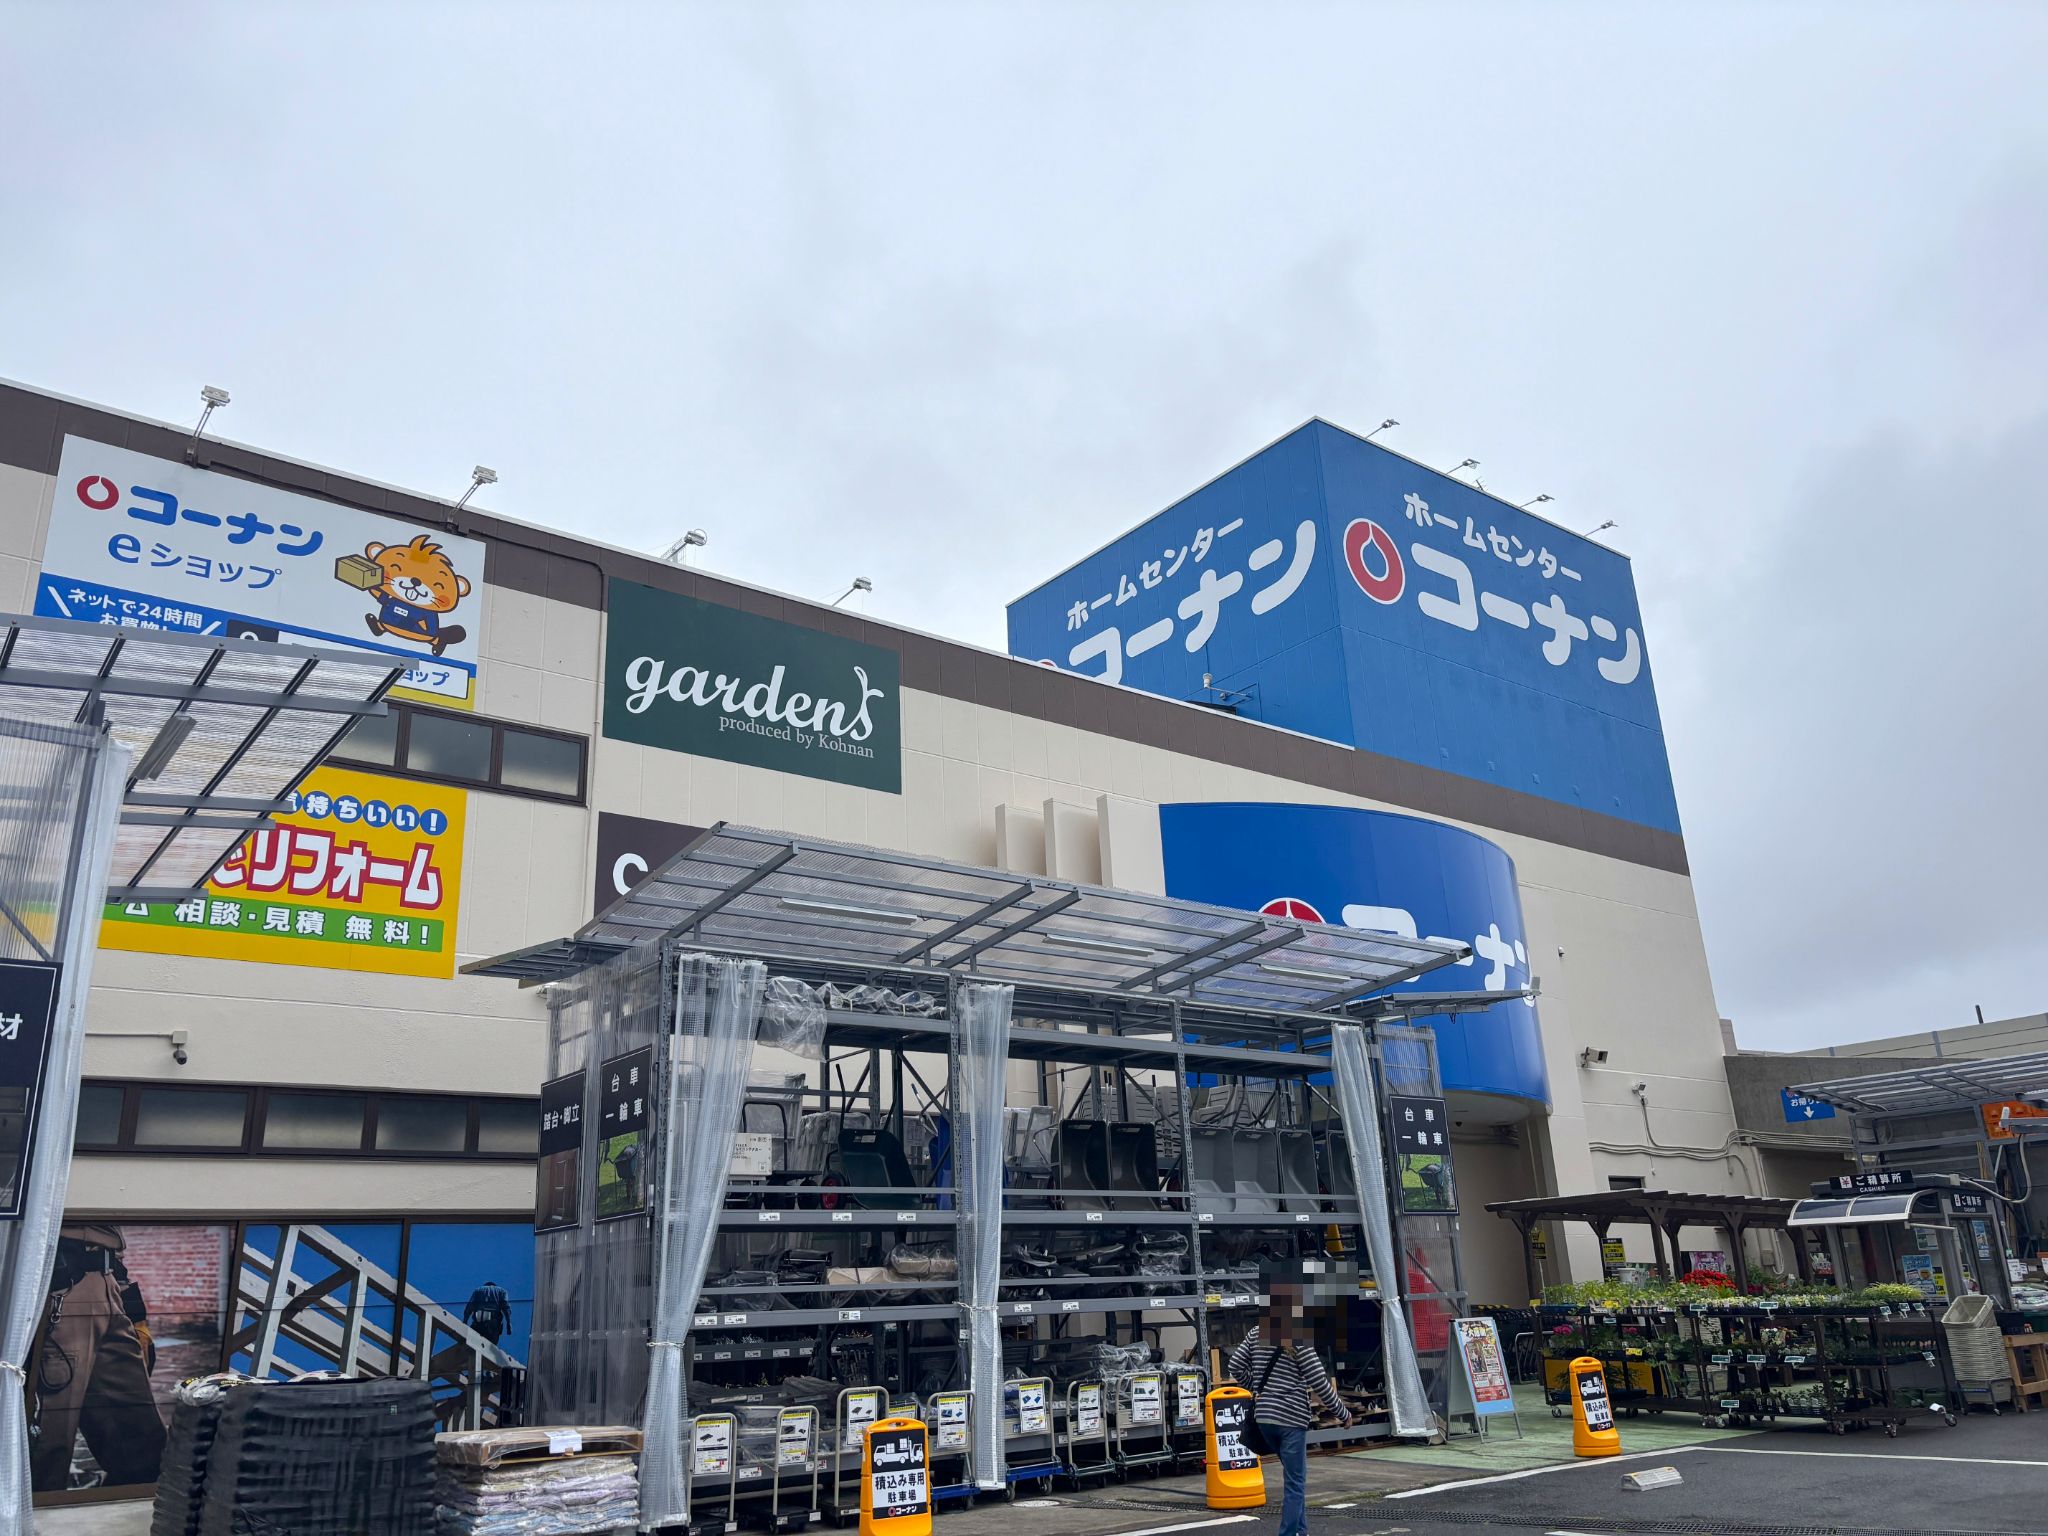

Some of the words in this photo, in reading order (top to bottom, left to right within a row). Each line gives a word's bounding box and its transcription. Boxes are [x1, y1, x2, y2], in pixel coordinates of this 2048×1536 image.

[127, 485, 324, 557] コーナン
[1404, 492, 1582, 581] ホームセンター
[108, 531, 282, 590] eショップ
[1066, 518, 1244, 631] ホームセンター
[68, 588, 203, 629] ネットで24時間
[1068, 520, 1316, 685] コーナン
[1410, 542, 1641, 685] コーナン
[719, 716, 792, 742] produced
[795, 727, 814, 749] by
[818, 732, 874, 759] Kohnan
[174, 898, 326, 936] 相談・見積
[345, 914, 430, 945] 無料!
[611, 1066, 639, 1092] 台車
[605, 1097, 643, 1122] 一輪車
[1404, 1106, 1435, 1123] 台車
[1401, 1130, 1443, 1146] 一輪車
[874, 1472, 925, 1490] 積込み専用
[888, 1489, 917, 1503] 駐車場
[895, 1505, 917, 1514] コーナン
